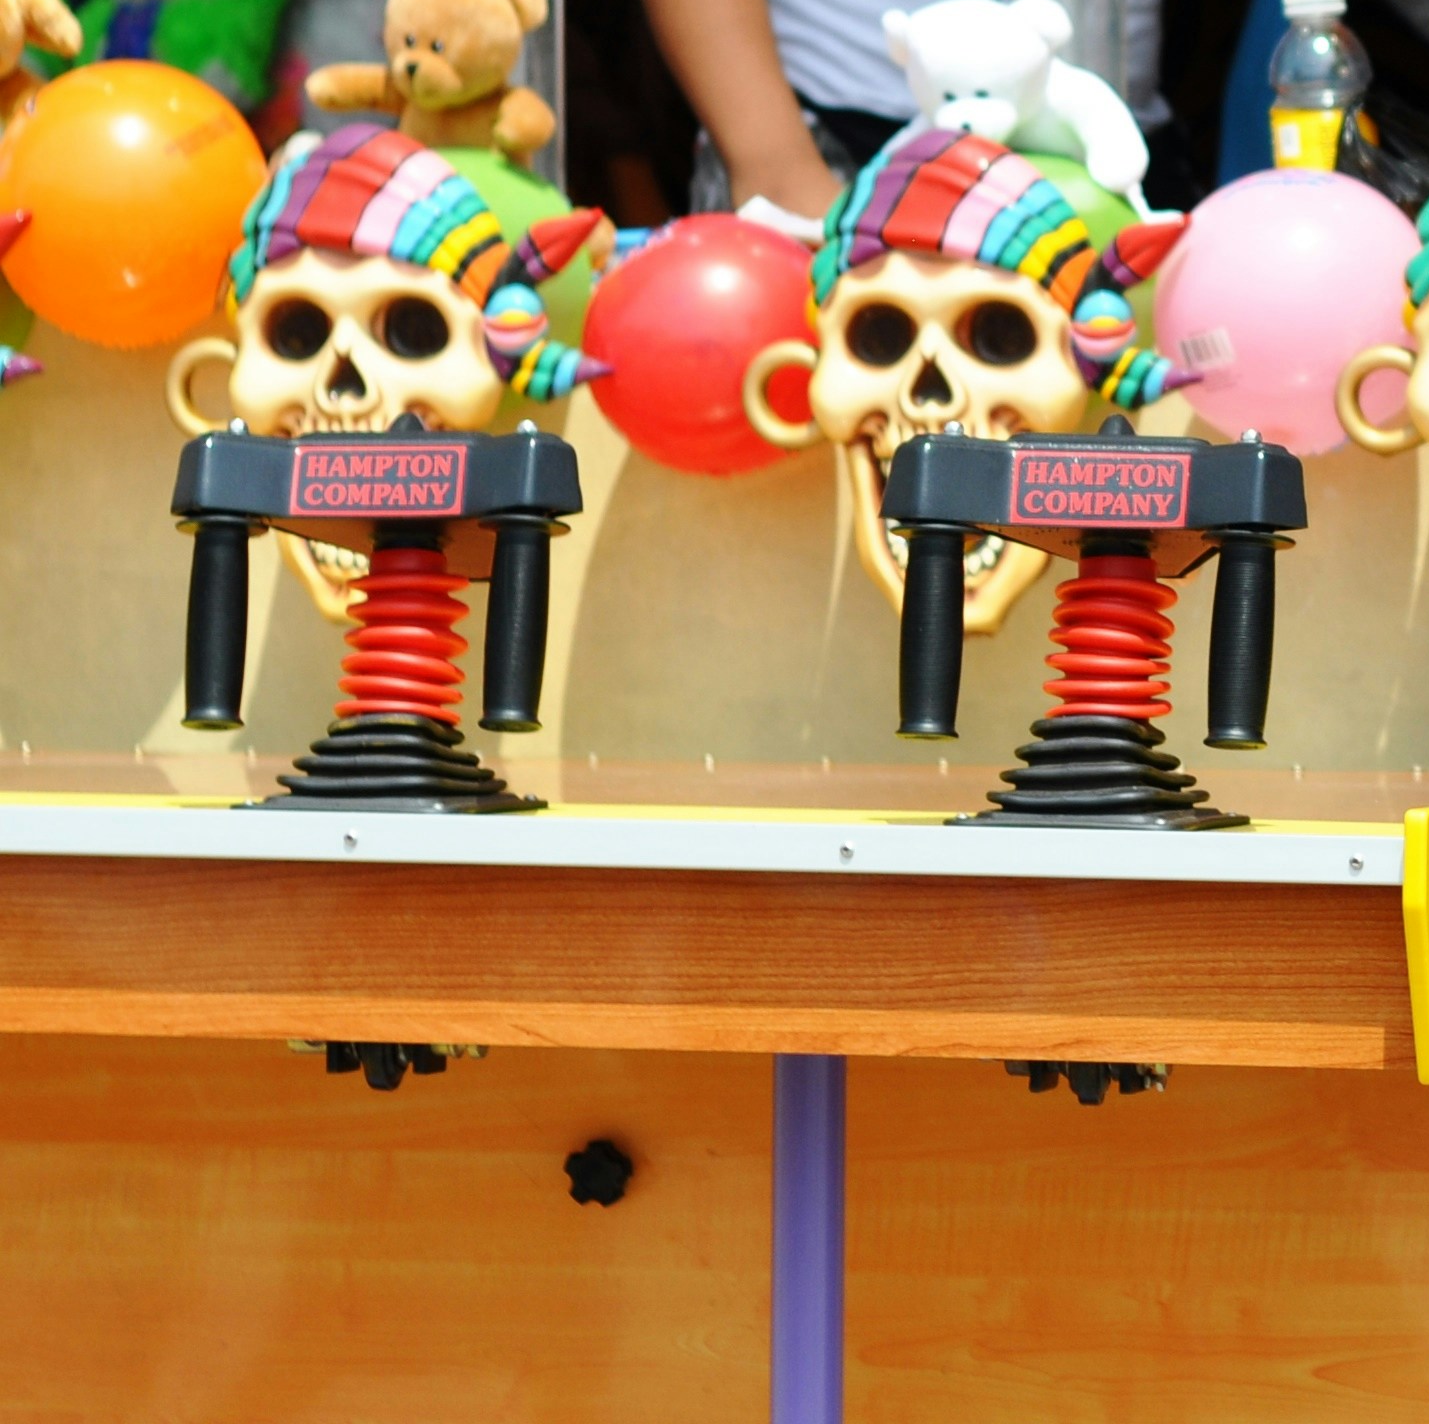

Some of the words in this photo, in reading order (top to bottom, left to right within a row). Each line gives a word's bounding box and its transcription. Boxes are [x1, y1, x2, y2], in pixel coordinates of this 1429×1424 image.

[306, 453, 453, 478] HAMPTON
[1024, 461, 1176, 488] HAMPTON
[304, 482, 452, 507] COMPANY
[1023, 489, 1175, 517] COMPANY
